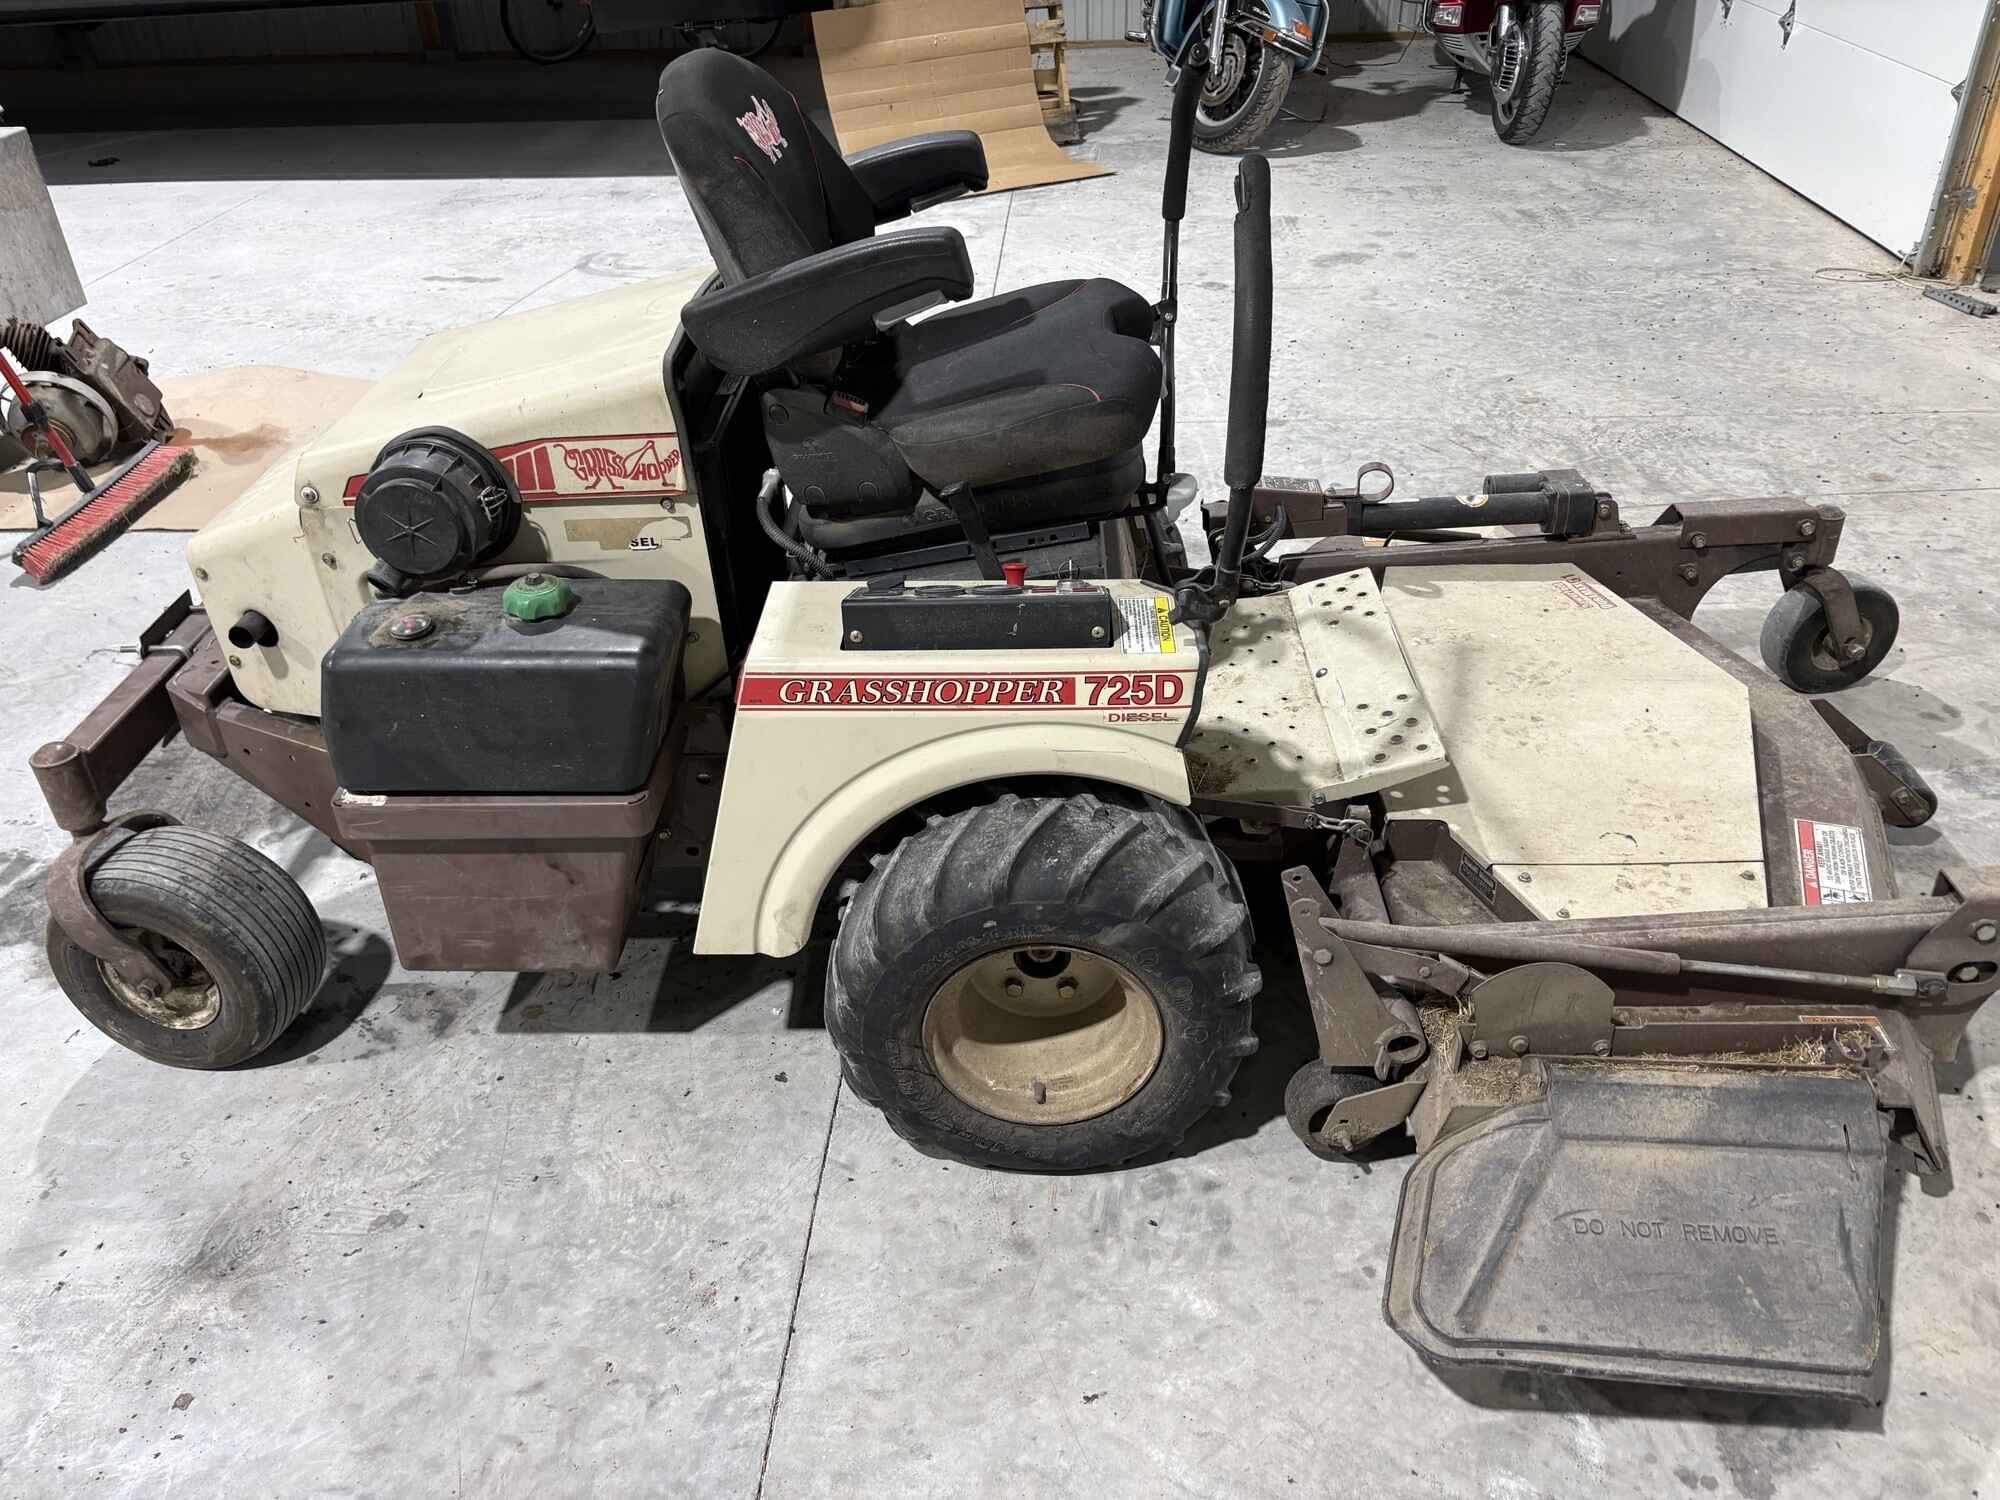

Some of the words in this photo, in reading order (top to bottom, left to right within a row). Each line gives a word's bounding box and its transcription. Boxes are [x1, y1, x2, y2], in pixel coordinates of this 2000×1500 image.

[631, 537, 659, 547] SEL
[1159, 615, 1171, 641] CAUTION
[778, 679, 1064, 705] GRASSHOPPER
[1084, 674, 1184, 706] 725D
[1108, 712, 1178, 723] DIESEL
[1801, 848, 1817, 879] DANGER
[1573, 1217, 1605, 1236] DO
[1620, 1219, 1664, 1239] NOT
